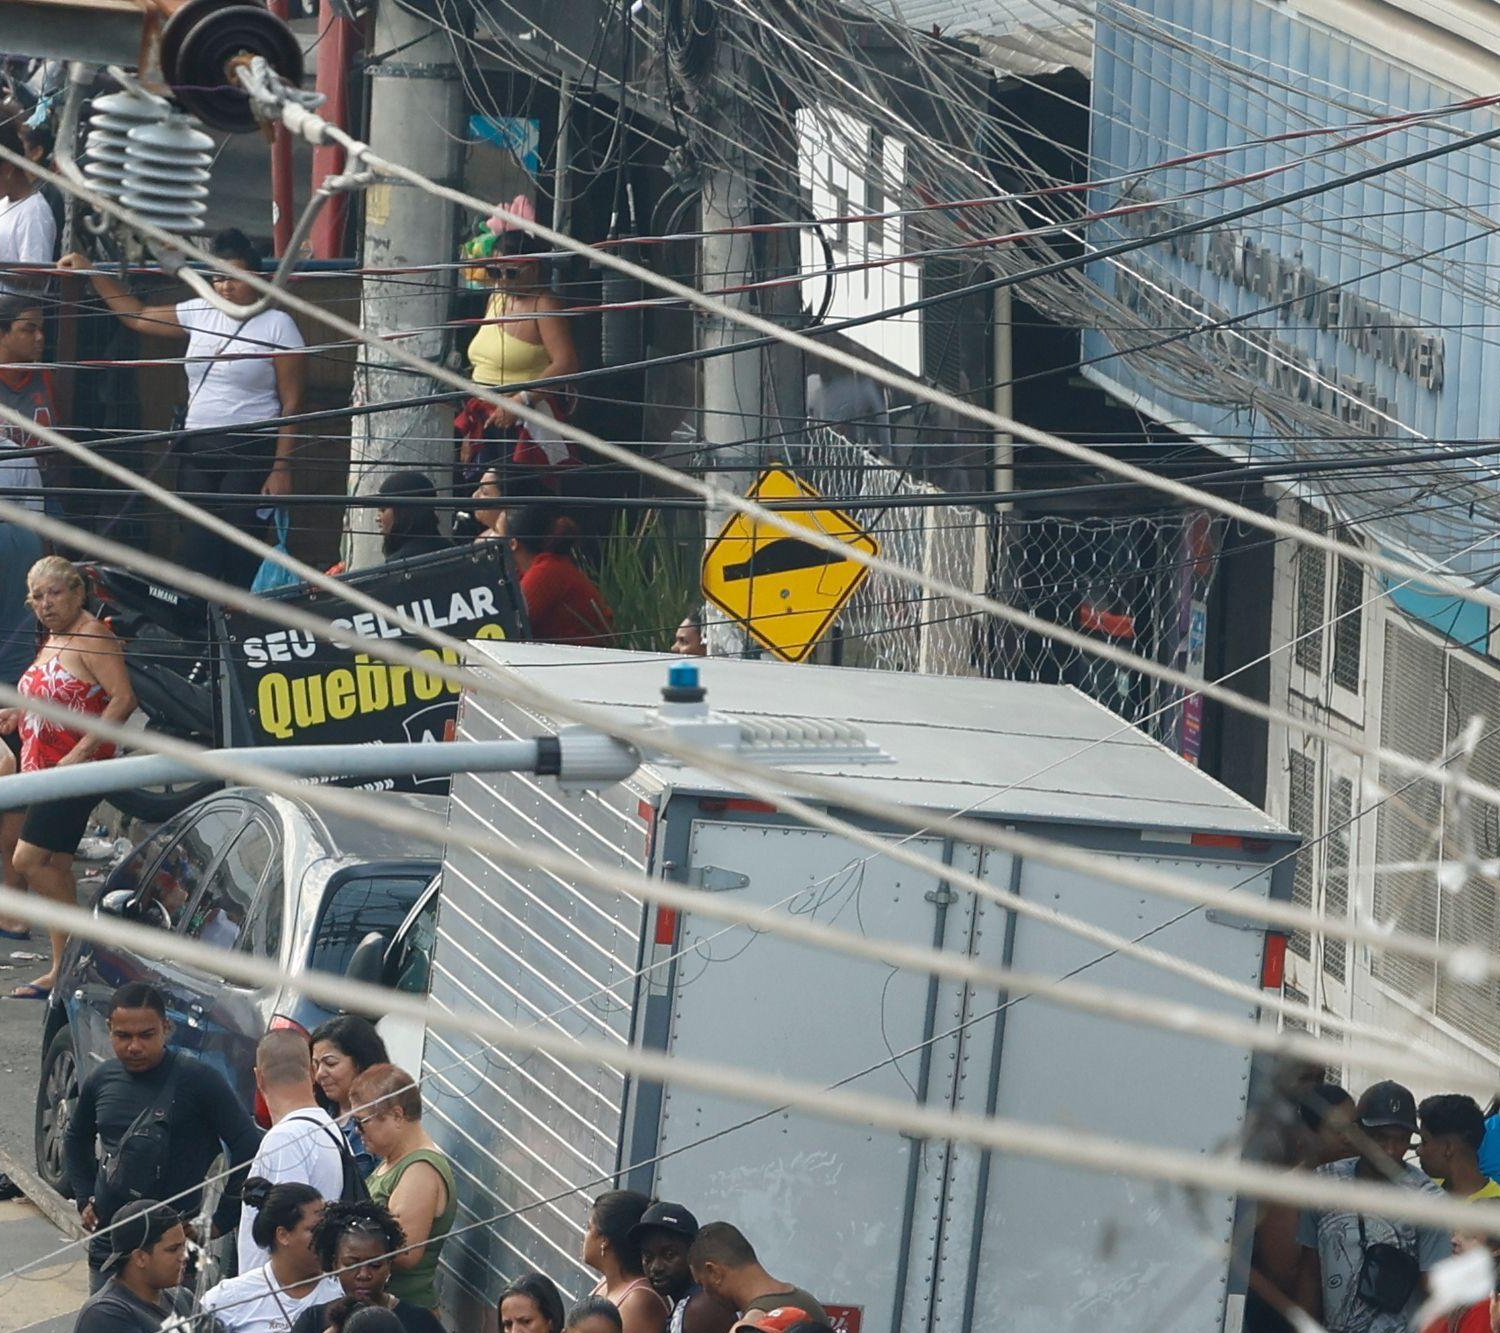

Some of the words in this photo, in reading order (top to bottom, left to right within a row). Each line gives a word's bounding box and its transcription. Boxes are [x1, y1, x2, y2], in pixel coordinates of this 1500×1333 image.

[149, 585, 178, 605] YAMAHA
[243, 628, 317, 669] SEU
[329, 586, 499, 649] CELULAR
